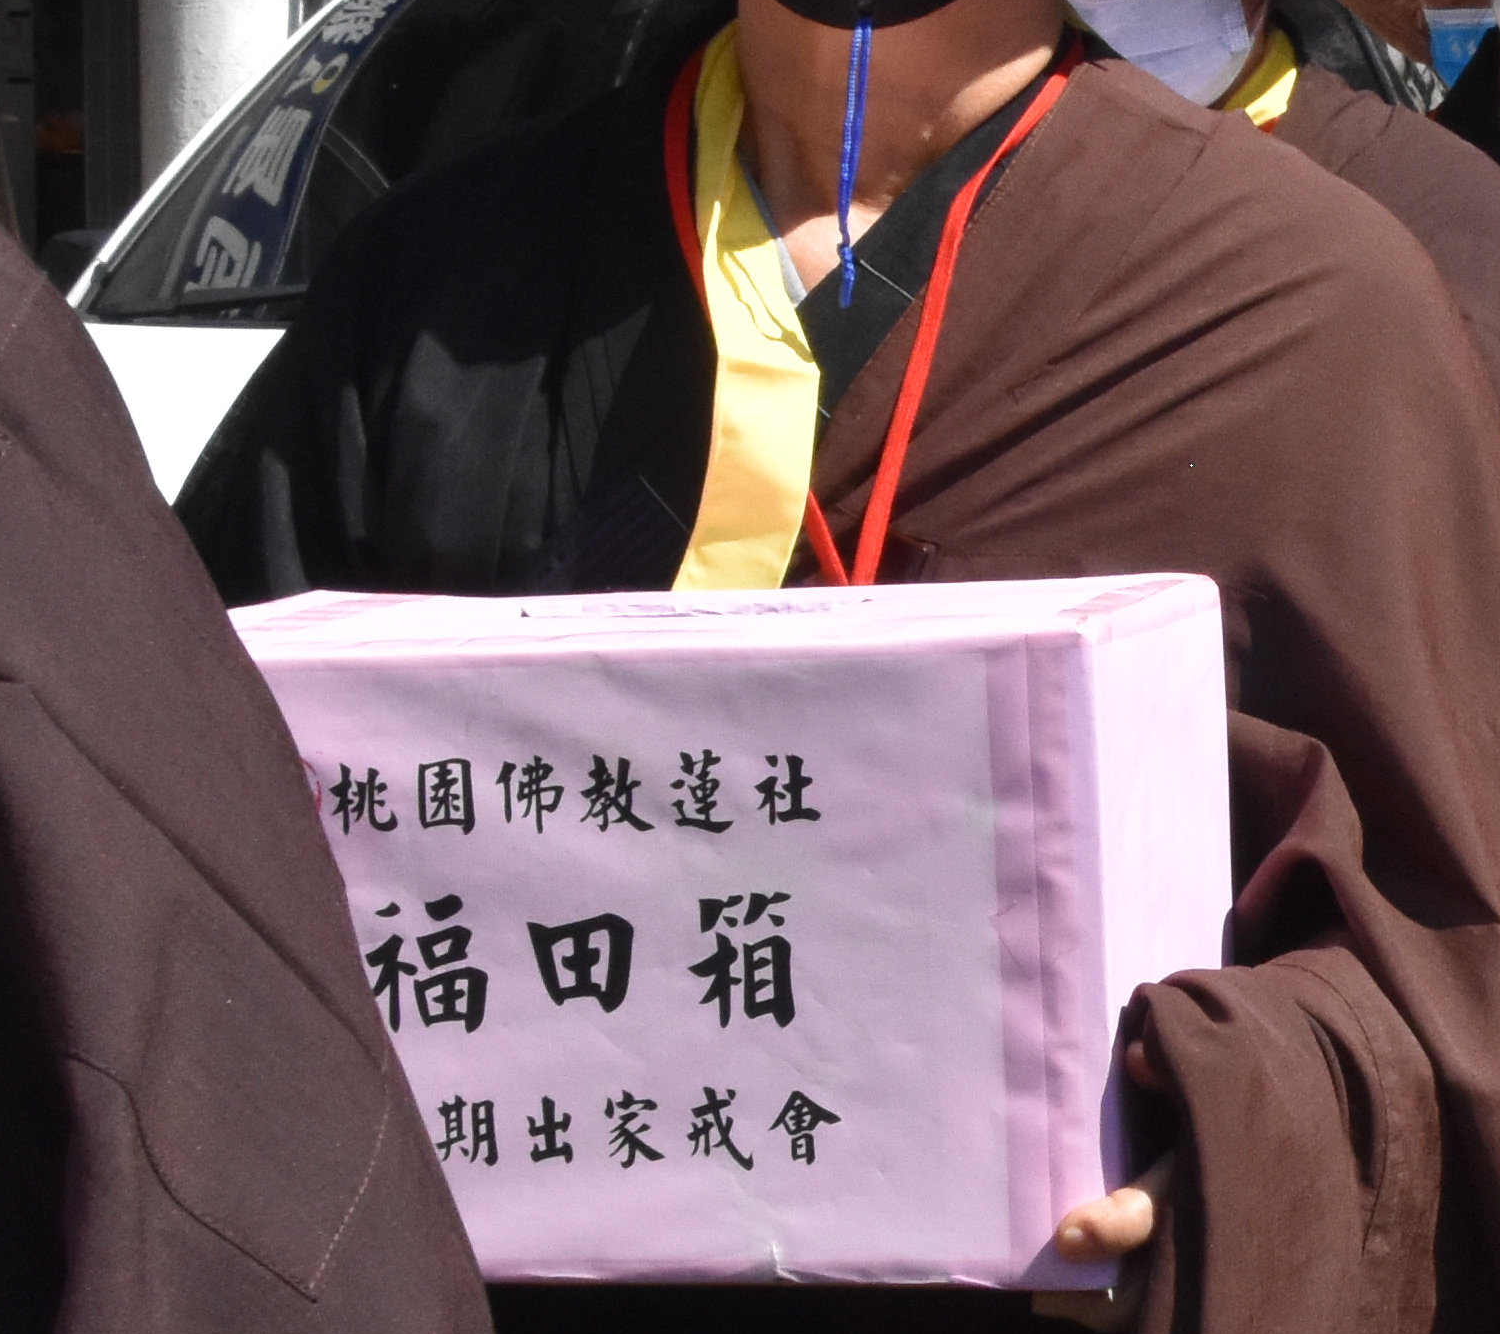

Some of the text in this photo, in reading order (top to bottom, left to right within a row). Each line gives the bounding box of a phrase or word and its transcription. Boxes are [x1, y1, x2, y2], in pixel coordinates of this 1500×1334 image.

[329, 749, 823, 836] 桃園佛教蓮社
[365, 891, 795, 1034] 福田箱
[435, 1088, 843, 1170] 期出家戒會
